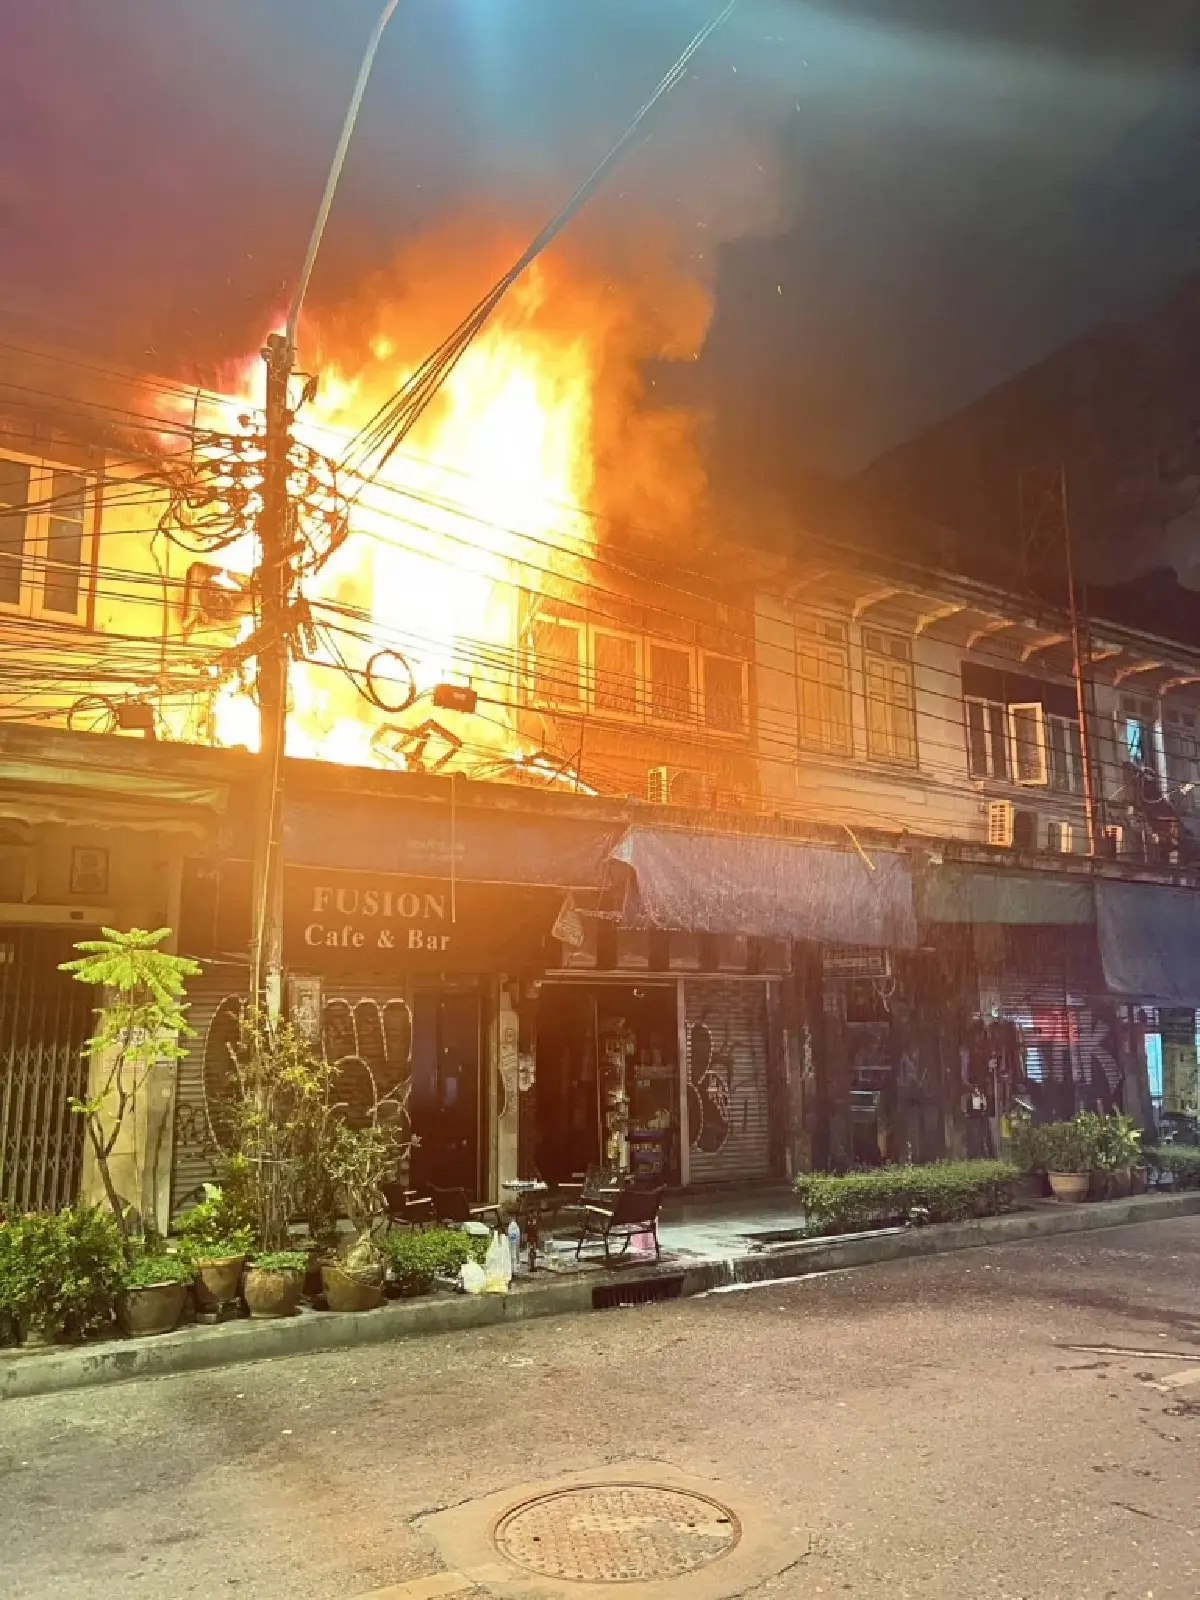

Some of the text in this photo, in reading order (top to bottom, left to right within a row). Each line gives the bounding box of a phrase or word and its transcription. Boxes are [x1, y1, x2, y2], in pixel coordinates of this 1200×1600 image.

[311, 886, 446, 919] FUSION
[304, 923, 451, 951] Cafe & Bar
